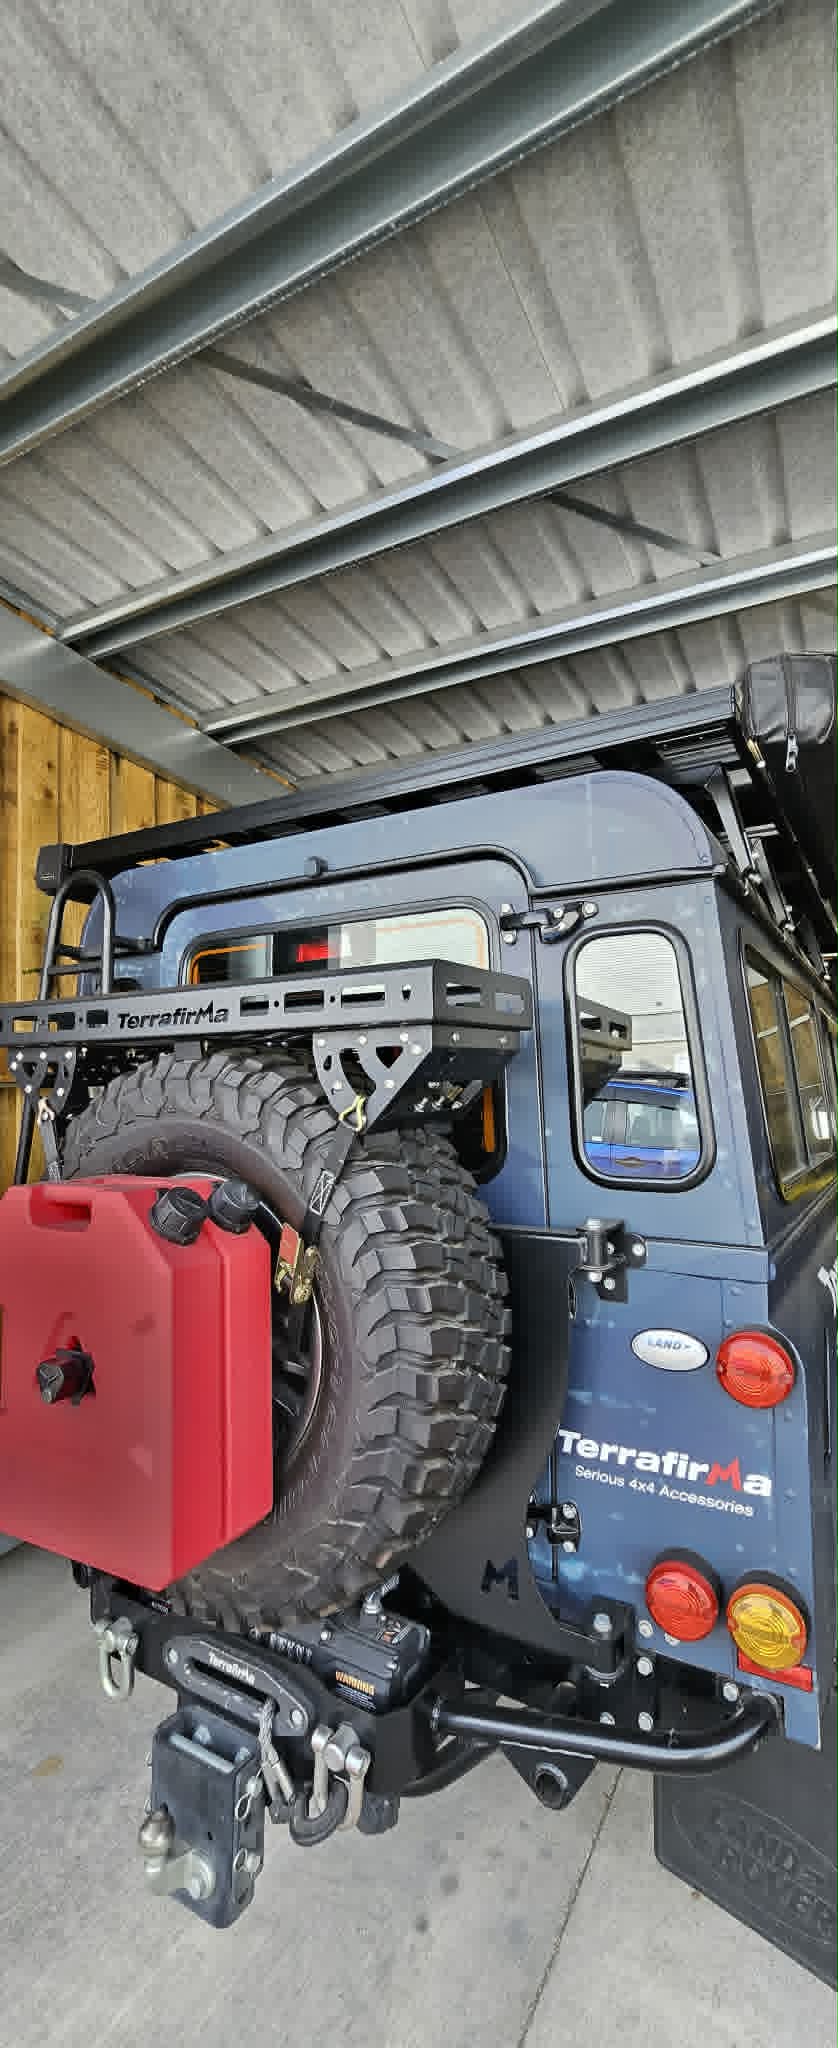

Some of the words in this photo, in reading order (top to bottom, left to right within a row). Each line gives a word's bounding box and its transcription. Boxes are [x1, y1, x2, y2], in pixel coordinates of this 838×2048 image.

[118, 1000, 229, 1029] TerrafirMa
[558, 1429, 773, 1497] TerrafirMa
[575, 1464, 625, 1488] Serious
[628, 1479, 656, 1494] 4x4
[658, 1485, 754, 1517] Accessories
[335, 1671, 375, 1696] WARNING
